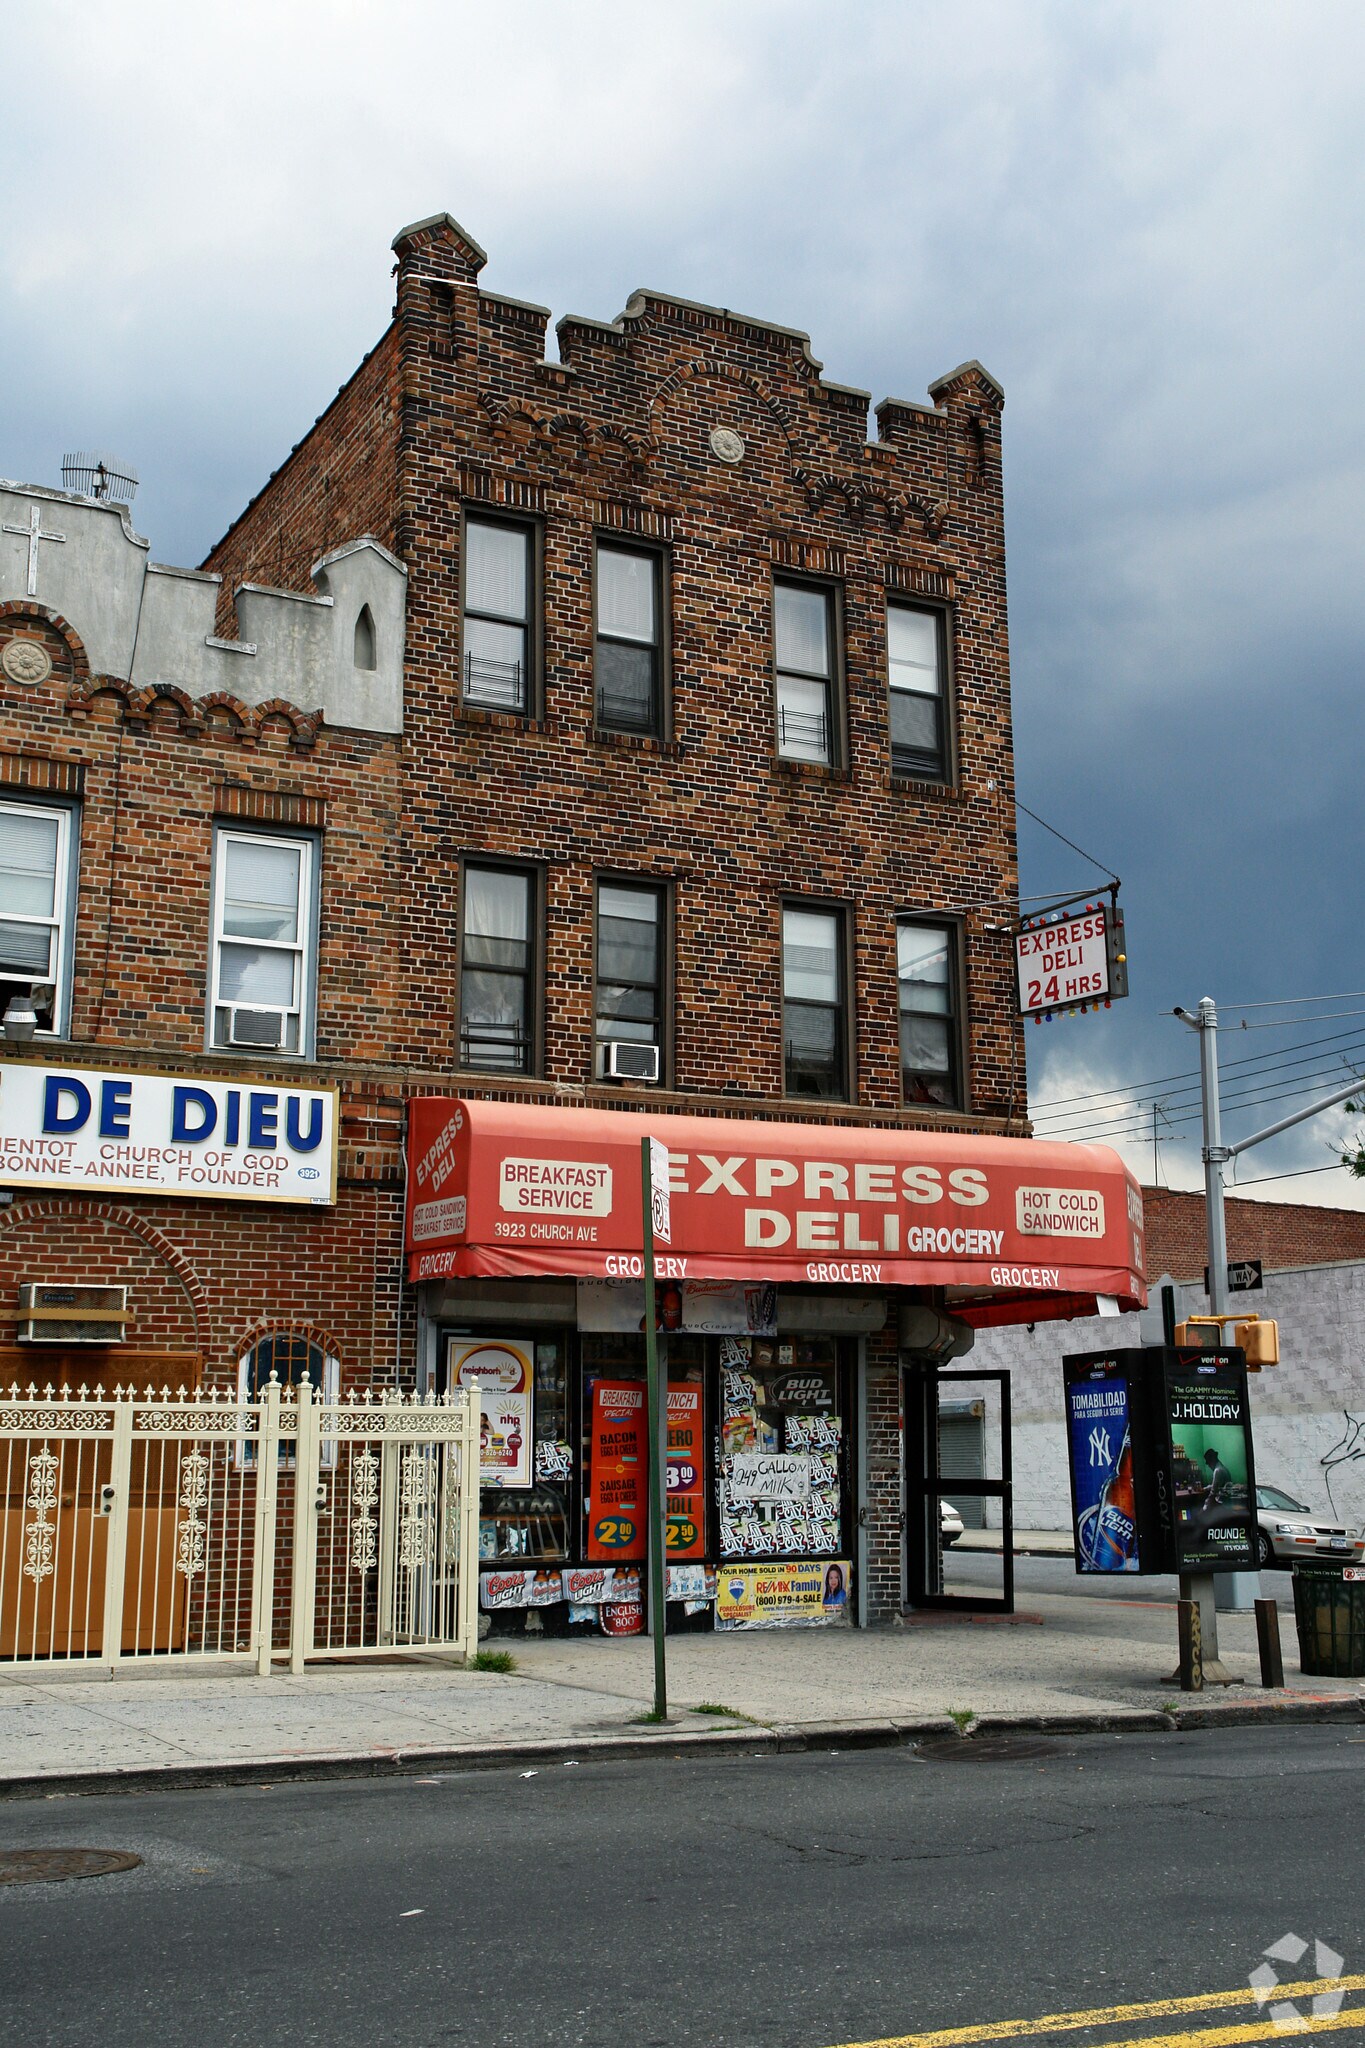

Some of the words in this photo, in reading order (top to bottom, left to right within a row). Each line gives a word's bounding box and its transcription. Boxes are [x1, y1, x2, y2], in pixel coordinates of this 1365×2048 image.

[1019, 915, 1105, 957] EXPRESS
[1042, 946, 1084, 973] DELI
[1028, 975, 1060, 1008] 24
[1065, 972, 1102, 997] HRS
[42, 1075, 132, 1139] DE
[171, 1085, 324, 1153] DIEU
[0, 1138, 77, 1157] IENTOT
[100, 1144, 192, 1165] CHURCH
[204, 1152, 232, 1167] OF
[243, 1154, 289, 1171] GOD
[416, 1108, 463, 1187] EXPRESS
[178, 1167, 280, 1188] FOUNDER
[299, 1169, 319, 1179] 3921
[431, 1148, 456, 1192] DELI
[504, 1164, 607, 1187] BREAKFAST
[518, 1188, 593, 1210] SERVICE
[1023, 1191, 1051, 1208] HOT
[1059, 1194, 1098, 1211] COLD
[414, 1206, 424, 1221] HOT
[425, 1203, 439, 1218] COLD
[439, 1200, 466, 1217] SANDWICH
[414, 1219, 442, 1237] BREAKFAST
[443, 1215, 464, 1230] SERVICE
[744, 1208, 899, 1252] DELI
[907, 1226, 1004, 1255] GROCERY
[1023, 1212, 1099, 1232] SANDWICH
[494, 1222, 526, 1238] 3923
[530, 1223, 574, 1241] CHURCH
[576, 1226, 598, 1242] AVE
[419, 1251, 457, 1276] GROCERY
[605, 1256, 688, 1277] GROERY
[806, 1262, 882, 1283] GROCERY
[991, 1266, 1060, 1287] GROCERY
[1235, 1270, 1253, 1282] WAY
[1201, 1355, 1229, 1366] verizon
[786, 1379, 823, 1389] BUD
[1212, 1387, 1236, 1395] Nominee
[602, 1390, 640, 1407] BREAKFAST
[667, 1393, 695, 1408] UNCH
[778, 1389, 831, 1400] LIGHT
[1071, 1391, 1126, 1410] TOMABILIDAD
[500, 1414, 520, 1427] nhp
[603, 1408, 633, 1418] SPECIAL
[667, 1411, 691, 1421] ECIAL
[1074, 1410, 1086, 1419] PARA
[1087, 1409, 1103, 1418] SEGUIR
[1103, 1408, 1109, 1417] LA
[1110, 1407, 1124, 1416] SERIE
[1172, 1403, 1240, 1419] J.HOLIDAY
[600, 1431, 637, 1445] BACON
[600, 1445, 613, 1457] EGGS
[620, 1443, 638, 1456] CHEESE
[758, 1459, 807, 1475] GALLON
[600, 1478, 636, 1492] SAUSAGE
[600, 1492, 614, 1504] EGGS
[1100, 1516, 1133, 1540] LIGHT
[1106, 1510, 1134, 1532] BUD
[1207, 1528, 1239, 1540] ROUND
[720, 1567, 738, 1575] YOUR
[739, 1567, 757, 1575] HOME
[786, 1565, 797, 1573] 90
[798, 1564, 821, 1573] DAYS
[487, 1573, 526, 1596] Coors
[568, 1570, 605, 1592] Coors
[756, 1580, 790, 1594] RE/MAX
[791, 1579, 822, 1593] Family
[492, 1584, 525, 1606] LIGHT
[574, 1582, 604, 1601] LIGHT
[756, 1595, 776, 1606] (800)
[778, 1594, 822, 1605] 979-4-SALE
[606, 1604, 643, 1618] ENGLISH
[720, 1604, 755, 1612] FORECLOSURE
[723, 1611, 752, 1619] SPECIALIST
